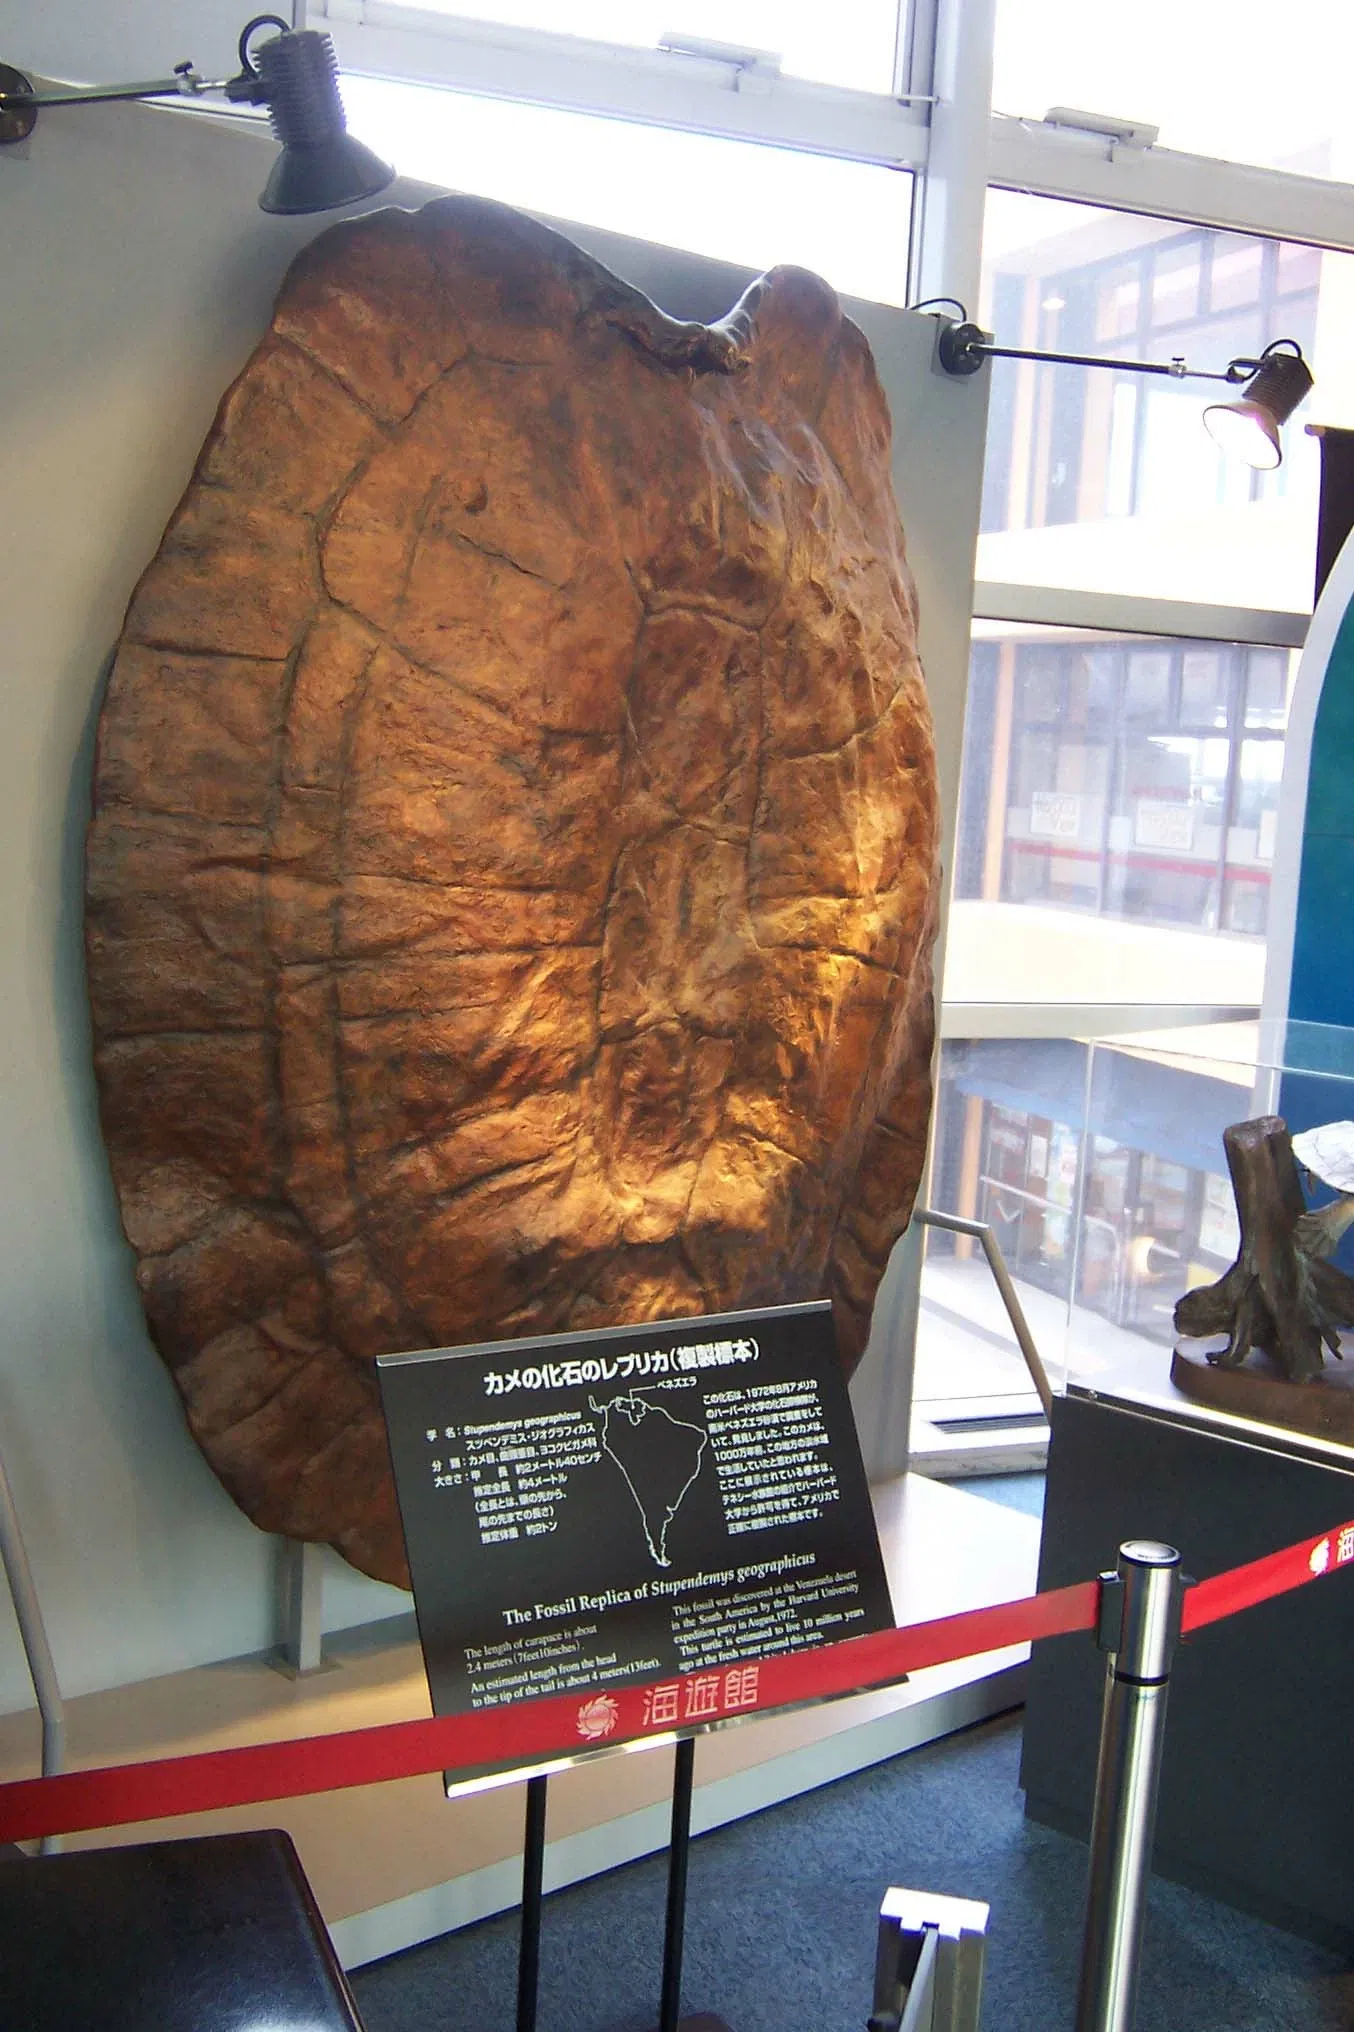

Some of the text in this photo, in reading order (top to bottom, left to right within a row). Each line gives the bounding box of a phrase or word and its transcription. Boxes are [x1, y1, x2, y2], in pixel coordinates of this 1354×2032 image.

[657, 1376, 696, 1389] ベネズエラ
[426, 1429, 437, 1441] 学
[432, 1460, 442, 1472] 分
[518, 1473, 567, 1490] 約4メートル
[526, 1522, 557, 1536] 約2トン
[502, 1609, 532, 1625] The
[534, 1597, 576, 1619] Fossil
[579, 1589, 632, 1610] Replica
[634, 1583, 648, 1599] of
[672, 1604, 691, 1616] This
[693, 1599, 714, 1612] fossil
[716, 1598, 731, 1606] was
[733, 1587, 773, 1603] discovered
[775, 1587, 782, 1595] at
[783, 1584, 795, 1592] the
[835, 1571, 856, 1582] desert
[672, 1584, 858, 1631] in the South America by the Harvard University
[464, 1649, 482, 1659] The
[484, 1641, 512, 1655] length
[513, 1639, 522, 1649] of
[525, 1633, 562, 1647] carapace
[574, 1625, 597, 1637] about
[674, 1628, 716, 1644] expedition
[716, 1624, 736, 1637] party
[738, 1620, 749, 1629] in
[679, 1609, 864, 1656] This turtle is estimated to live 10 million years
[467, 1662, 481, 1674] 2.4
[483, 1658, 513, 1670] meters
[679, 1632, 824, 1671] ago at the fresh water around this area.
[471, 1653, 616, 1694] An estimated length from the head
[472, 1699, 483, 1708] to
[483, 1694, 500, 1706] the
[499, 1691, 514, 1703] tip
[514, 1687, 524, 1698] of
[525, 1685, 541, 1696] the
[540, 1681, 555, 1693] tail
[556, 1680, 565, 1689] is
[566, 1674, 590, 1687] about
[591, 1672, 598, 1680] 4
[642, 1665, 760, 1727] 海遊館
